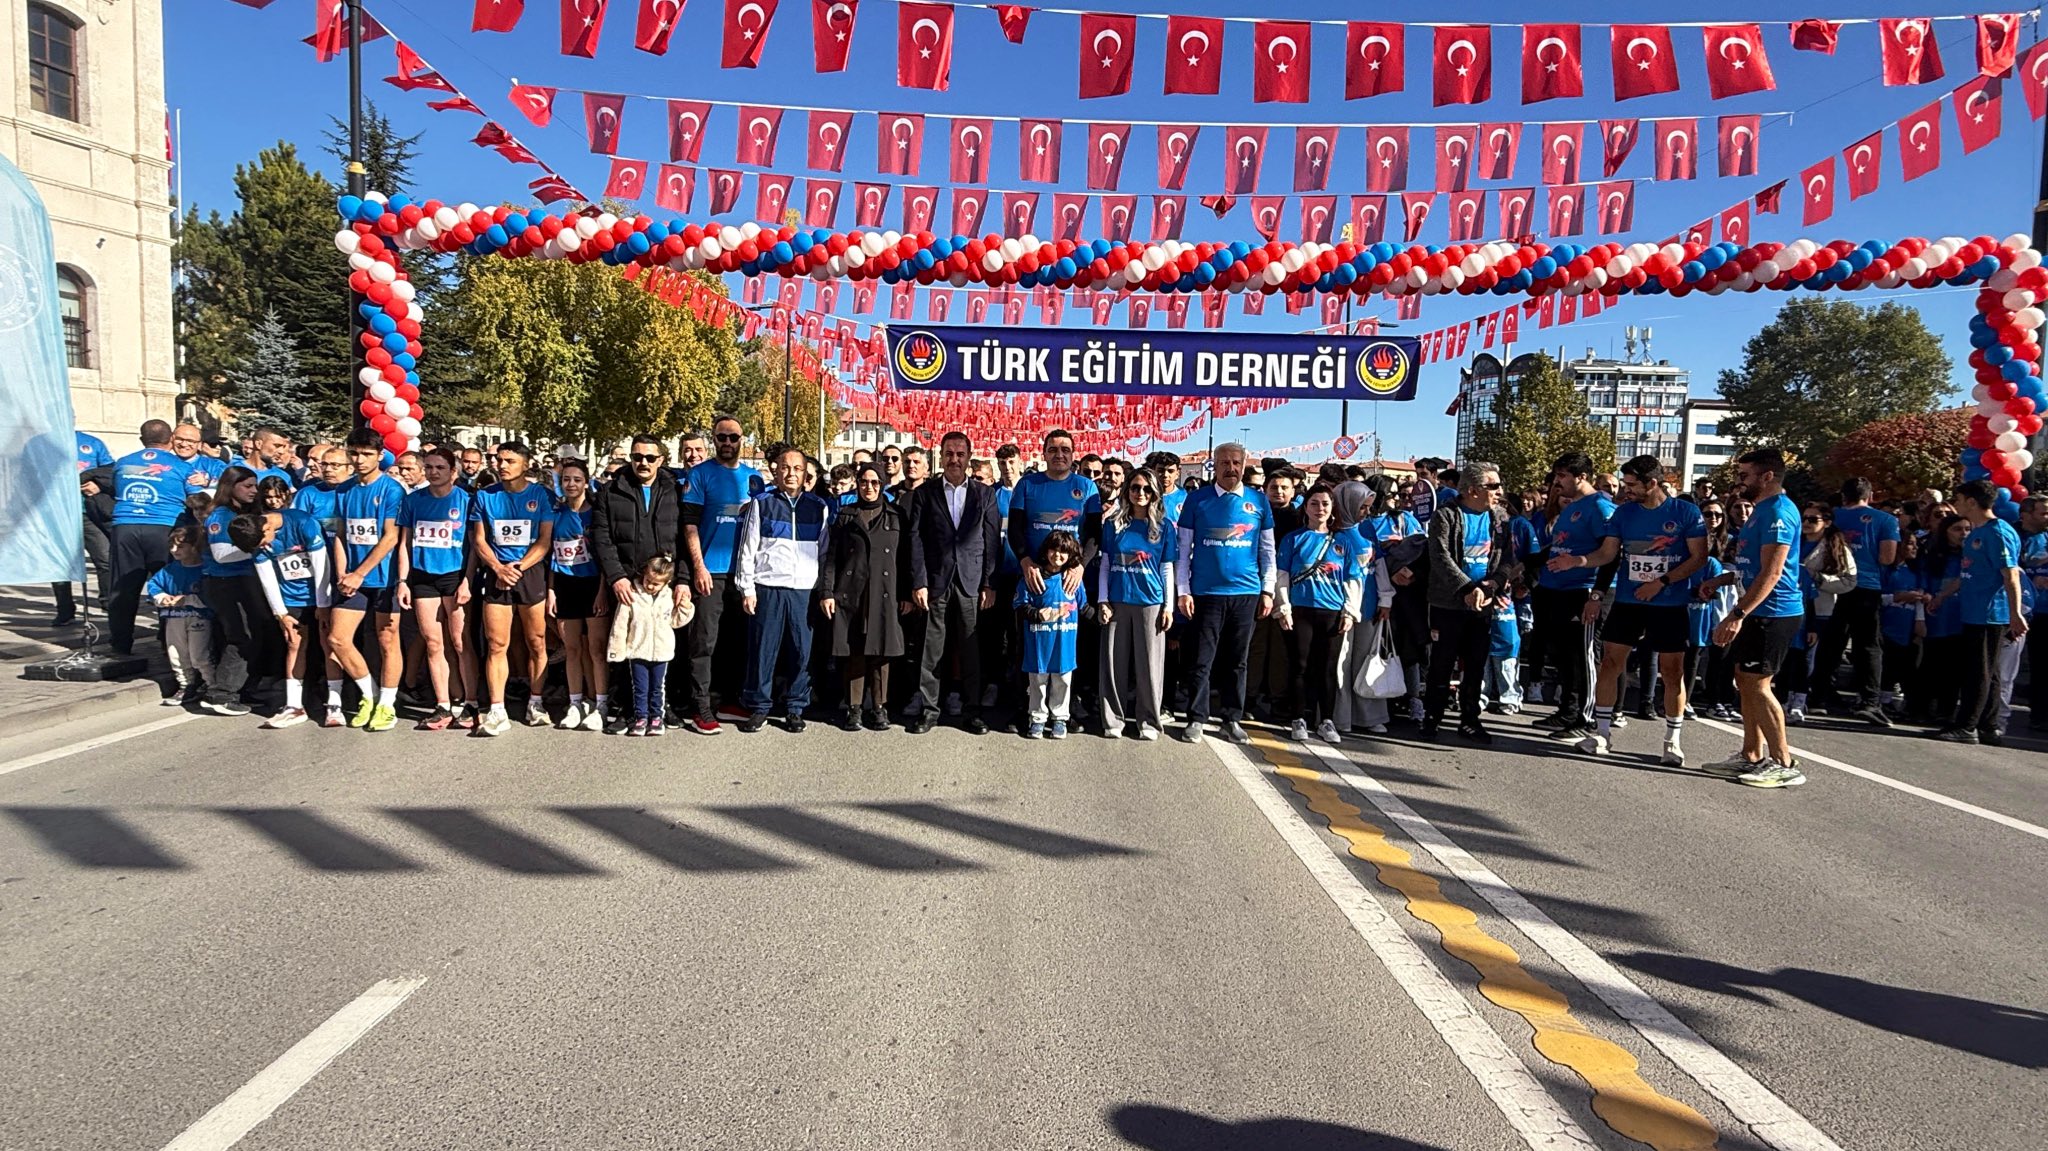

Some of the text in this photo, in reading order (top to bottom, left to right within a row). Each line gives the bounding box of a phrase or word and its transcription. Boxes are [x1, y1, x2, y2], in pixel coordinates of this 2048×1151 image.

[957, 339, 1347, 389] TÜRK EĞİTİM DERNEĞİ
[349, 524, 378, 536] 194
[418, 527, 449, 539] 110
[501, 525, 522, 536] 95
[556, 545, 585, 558] 182
[282, 557, 312, 572] 109
[1631, 561, 1666, 573] 354
